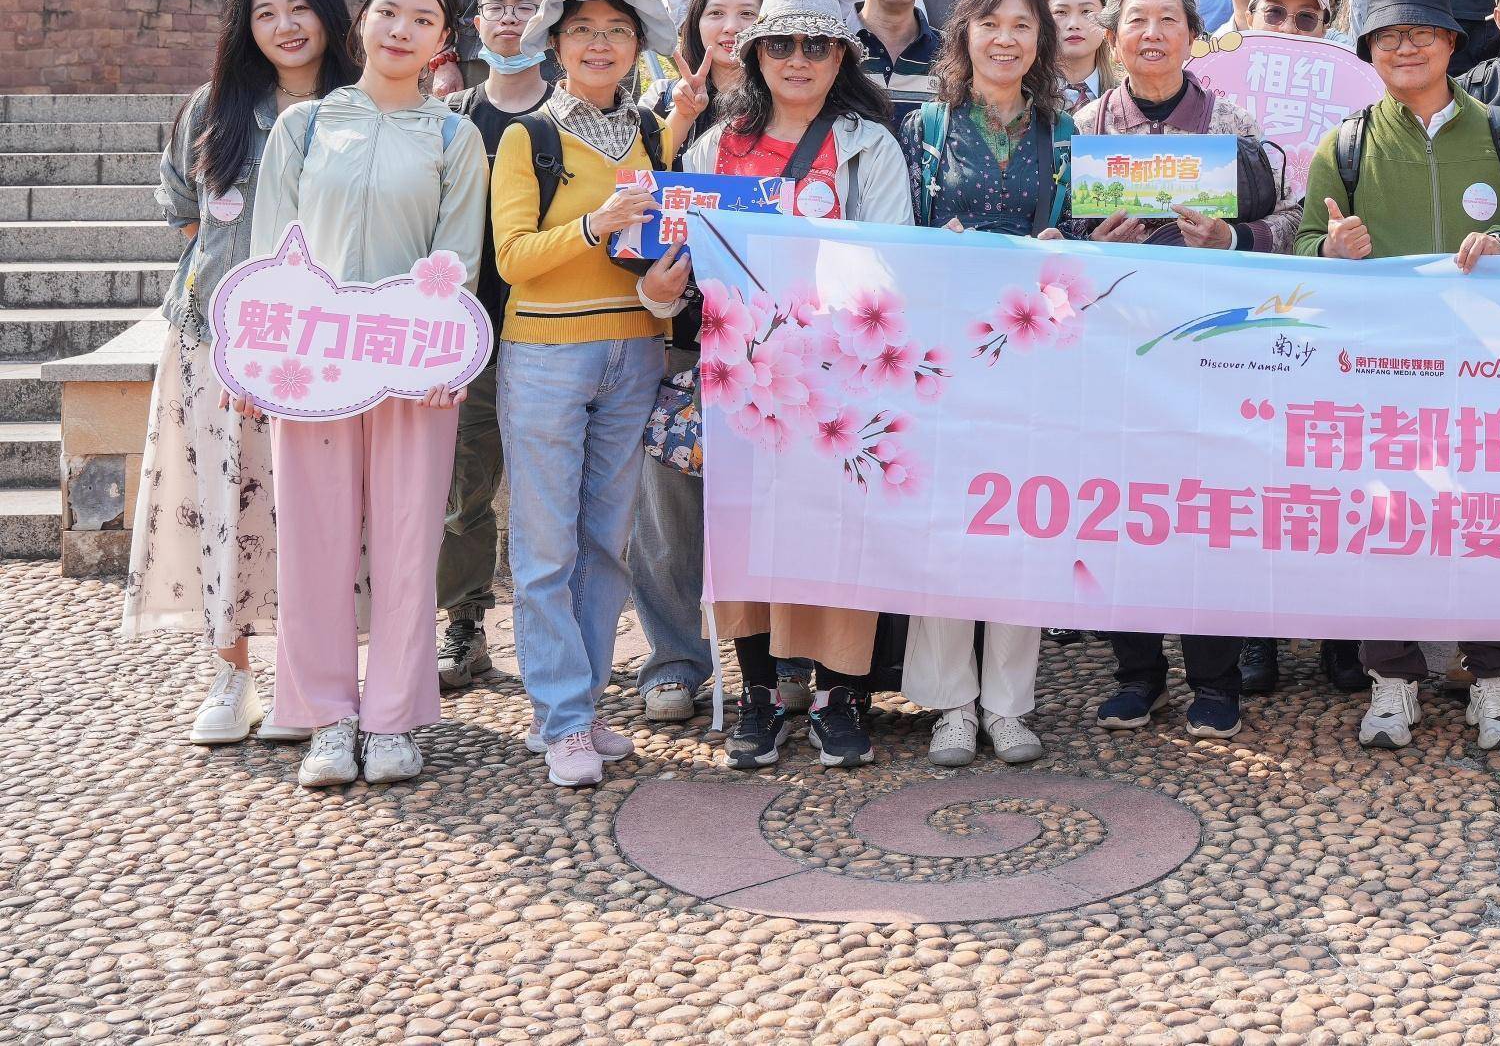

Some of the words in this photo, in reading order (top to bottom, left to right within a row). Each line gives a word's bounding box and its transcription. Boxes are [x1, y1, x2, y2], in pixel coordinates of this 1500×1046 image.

[1246, 51, 1335, 100] 相约
[1107, 155, 1200, 183] 南都拍客
[234, 299, 466, 368] 魅力南沙
[1199, 358, 1245, 370] Discover
[1248, 361, 1290, 372] Nansha
[1272, 333, 1316, 367] 南沙
[1355, 356, 1445, 371] 南方报业传媒集团
